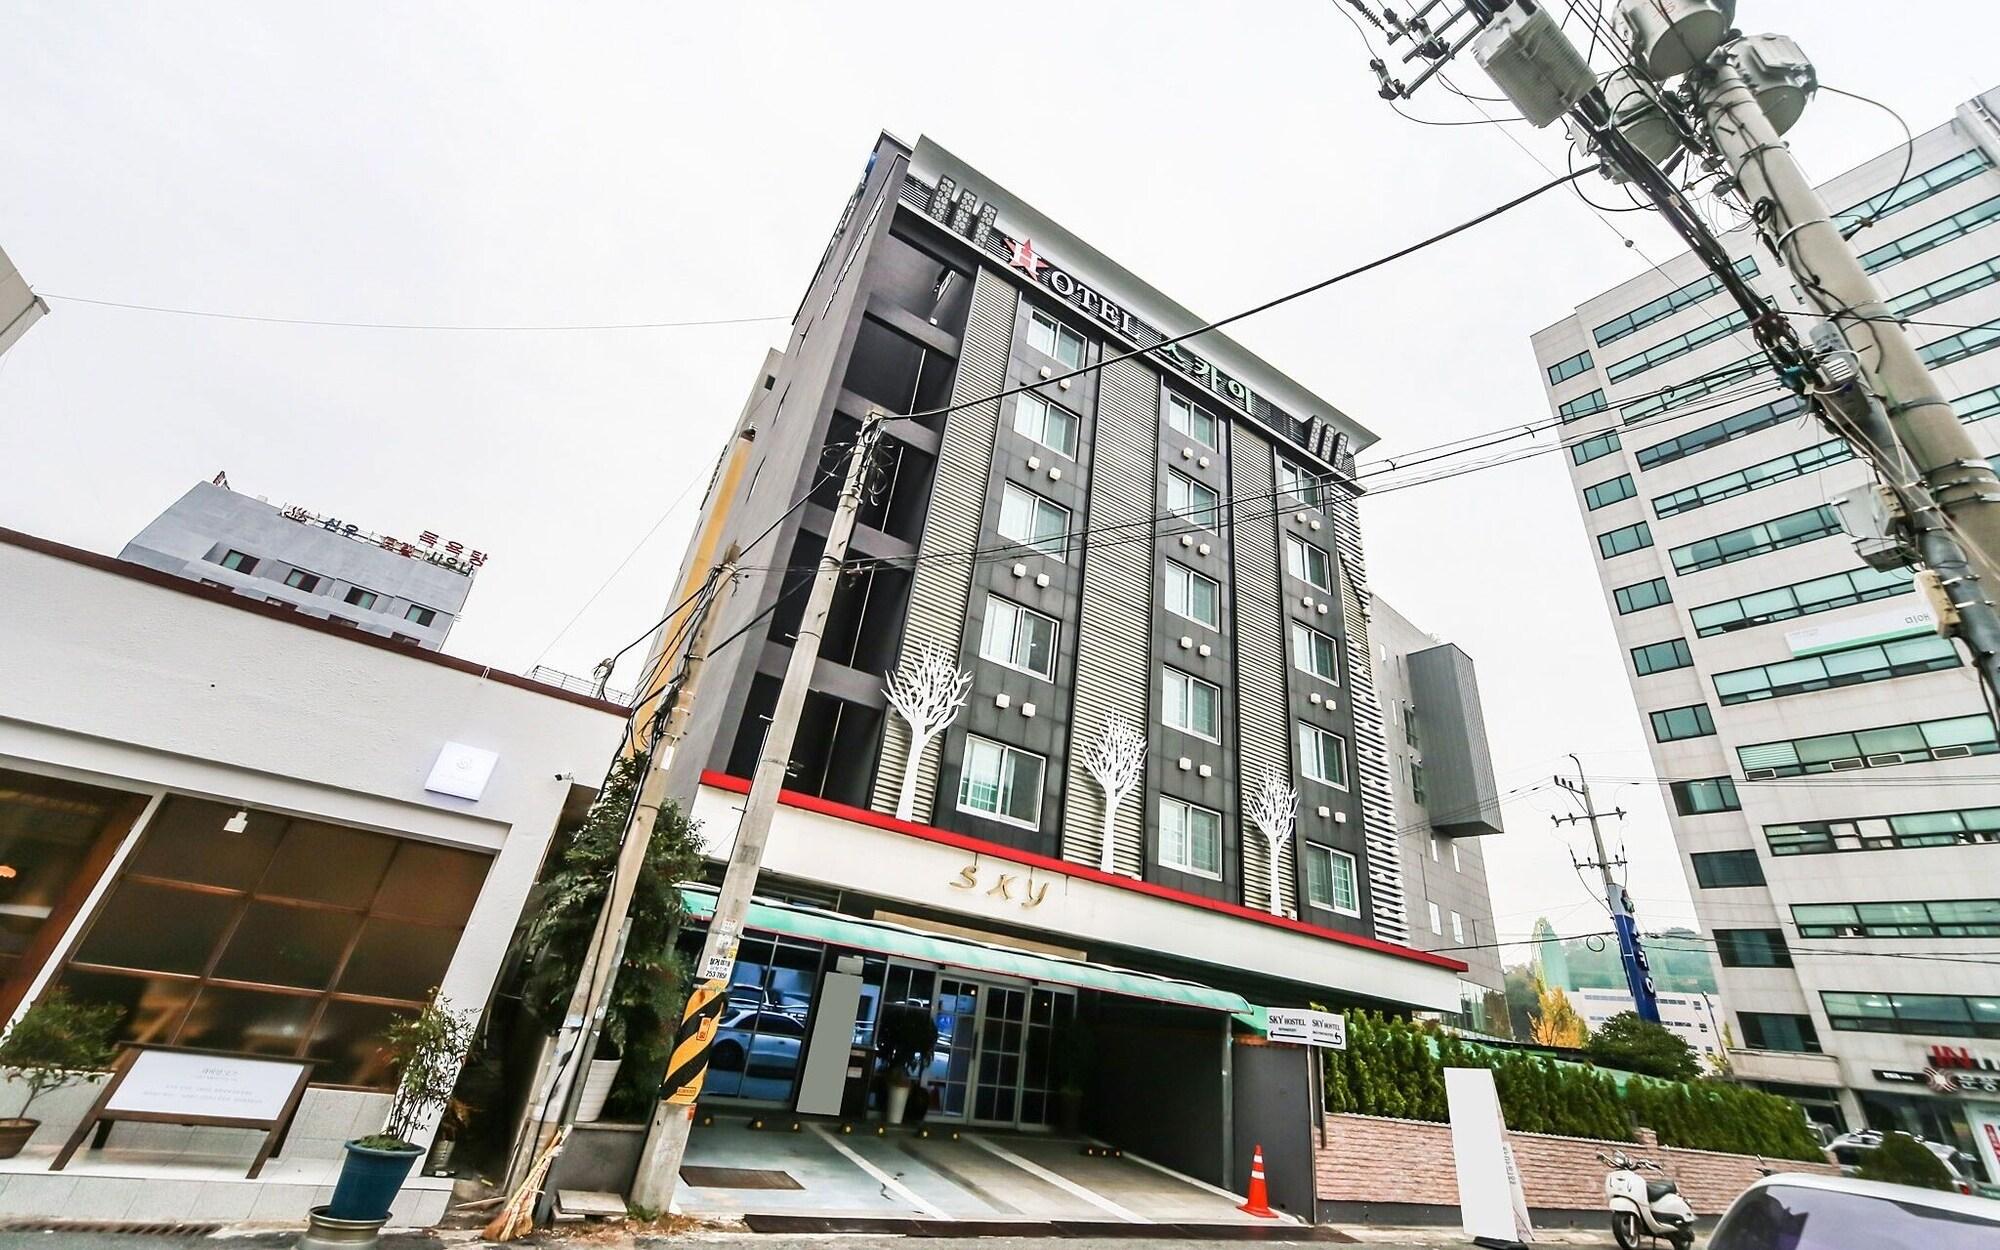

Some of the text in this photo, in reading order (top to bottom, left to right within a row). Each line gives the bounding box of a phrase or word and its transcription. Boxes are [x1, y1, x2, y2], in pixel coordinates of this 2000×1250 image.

[1012, 239, 1142, 340] HOTEL
[1157, 337, 1252, 413] 스카이
[419, 530, 488, 568] 목욕탕
[949, 865, 1049, 908] SKY
[1269, 1014, 1306, 1026] SKY HOSTEL
[1312, 1018, 1341, 1031] SKY HOSTEL
